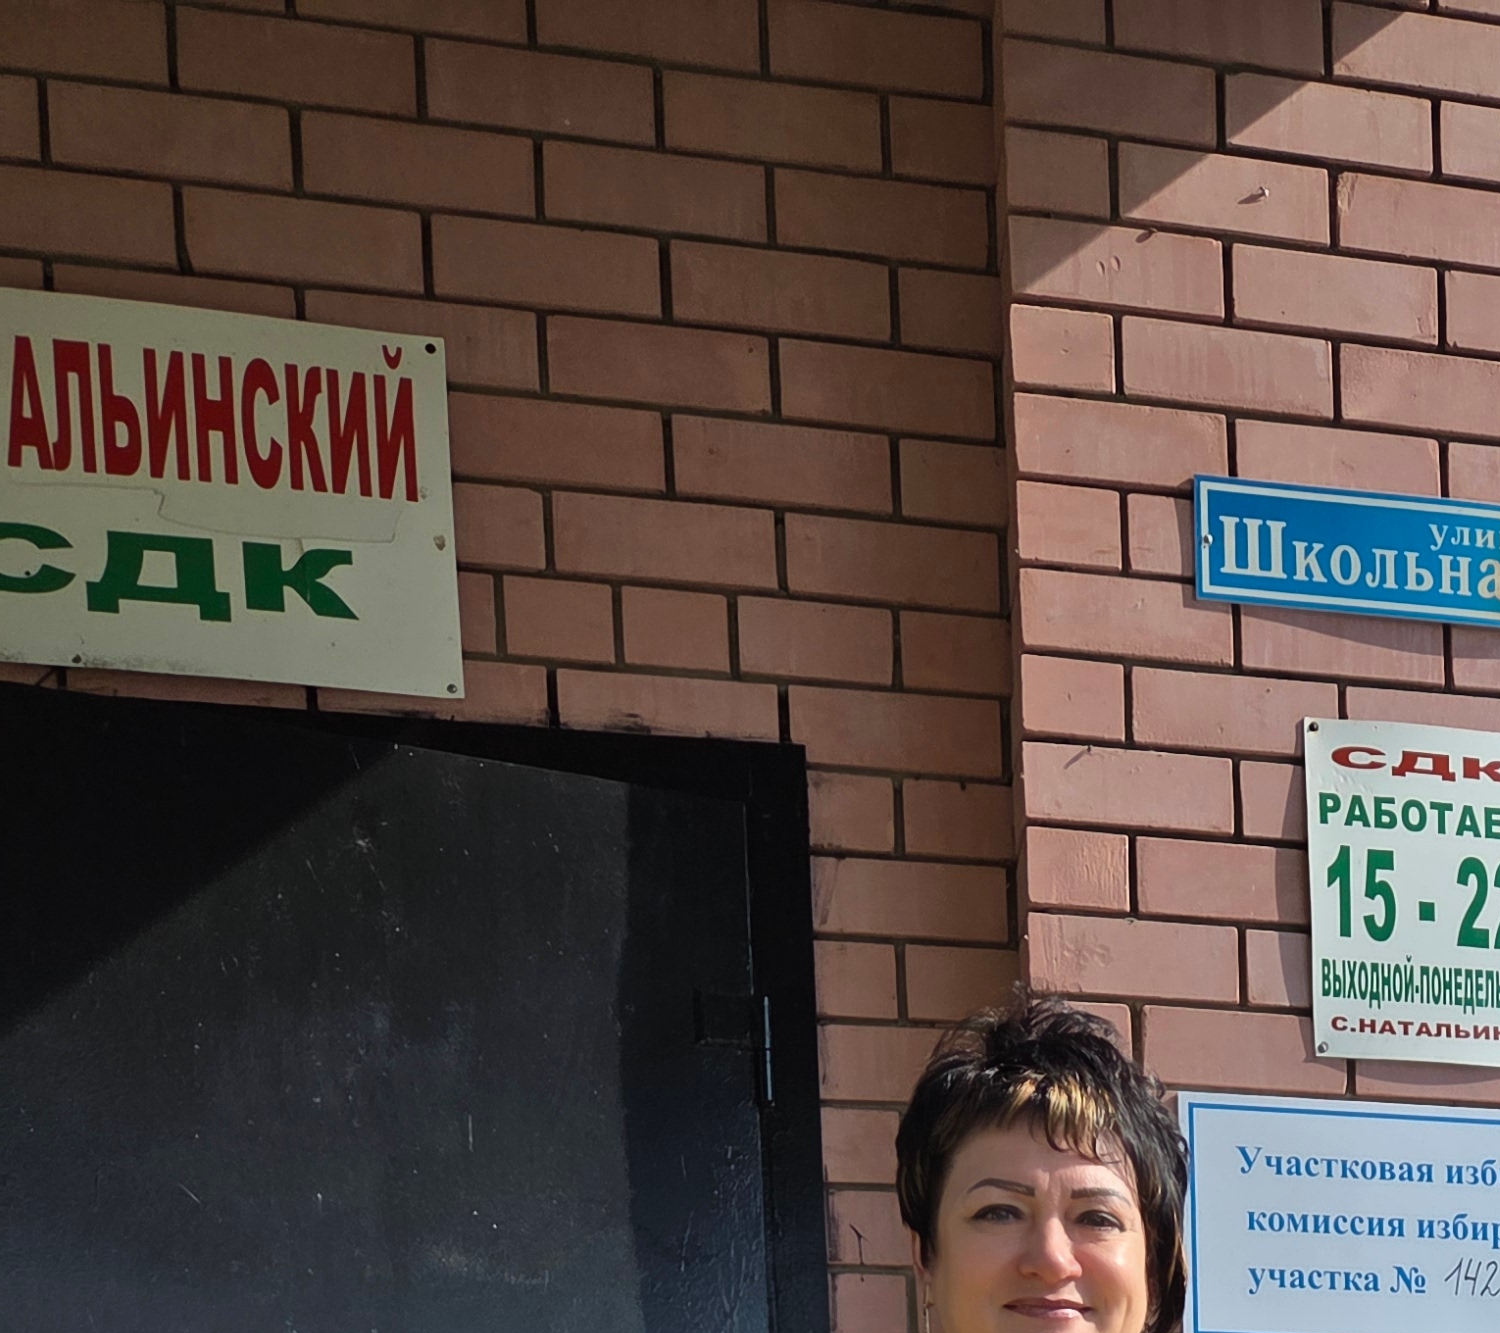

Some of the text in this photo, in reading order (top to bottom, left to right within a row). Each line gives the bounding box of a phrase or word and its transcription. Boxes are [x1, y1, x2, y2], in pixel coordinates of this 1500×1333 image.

[0, 521, 360, 622] СДК
[1327, 844, 1397, 942] 15
[1235, 1145, 1434, 1183] Участковая
[1247, 1210, 1405, 1238] комиссия
[1247, 1267, 1381, 1295] участка
[1389, 1265, 1427, 1294] №
